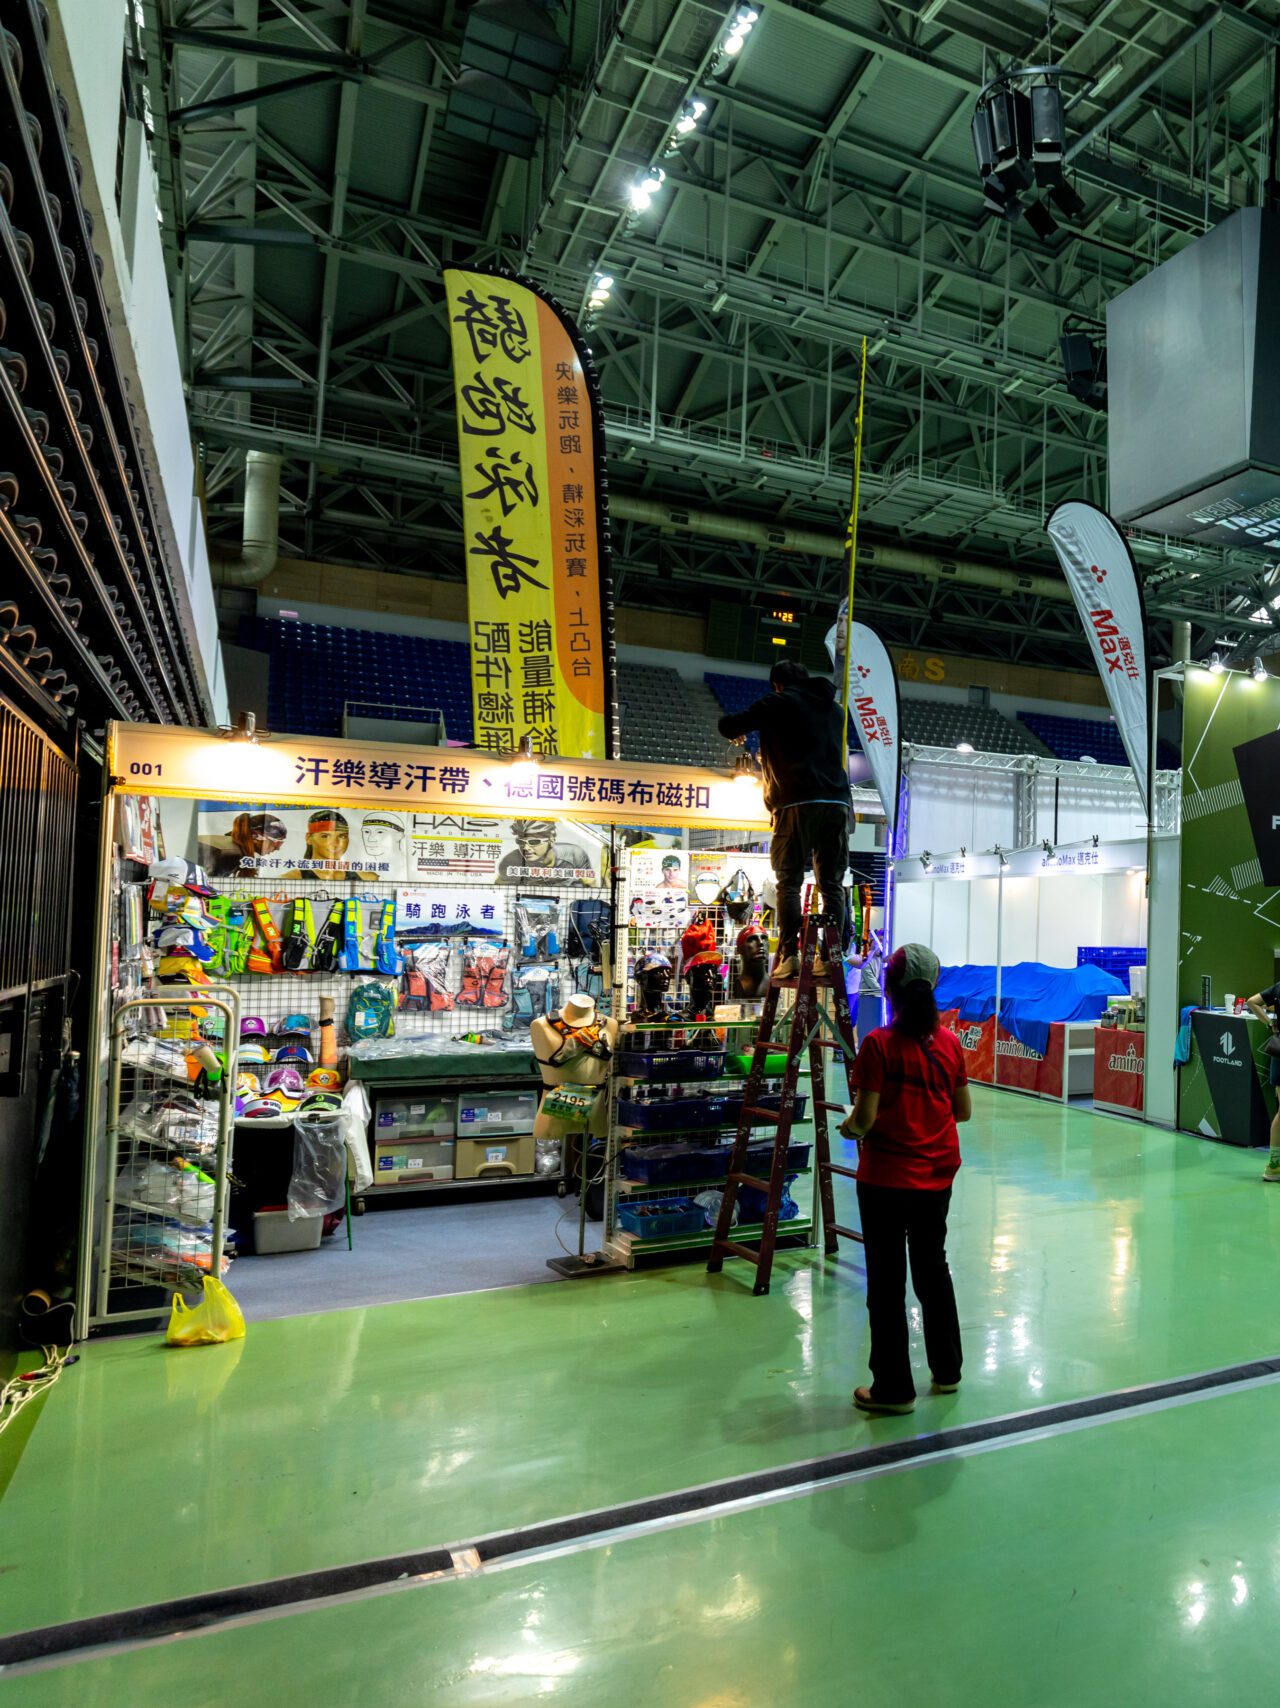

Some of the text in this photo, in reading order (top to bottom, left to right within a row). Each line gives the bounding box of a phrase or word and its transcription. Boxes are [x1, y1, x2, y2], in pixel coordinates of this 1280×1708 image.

[1186, 498, 1245, 524] NEW
[923, 657, 945, 682] S
[129, 762, 164, 777] 001
[294, 755, 711, 809] 汗樂導汗帶、德國號碼布磁扣
[405, 903, 496, 920] 騎跑泳者
[1213, 1056, 1243, 1067] FOOTLAND
[552, 1092, 587, 1107] 2195
